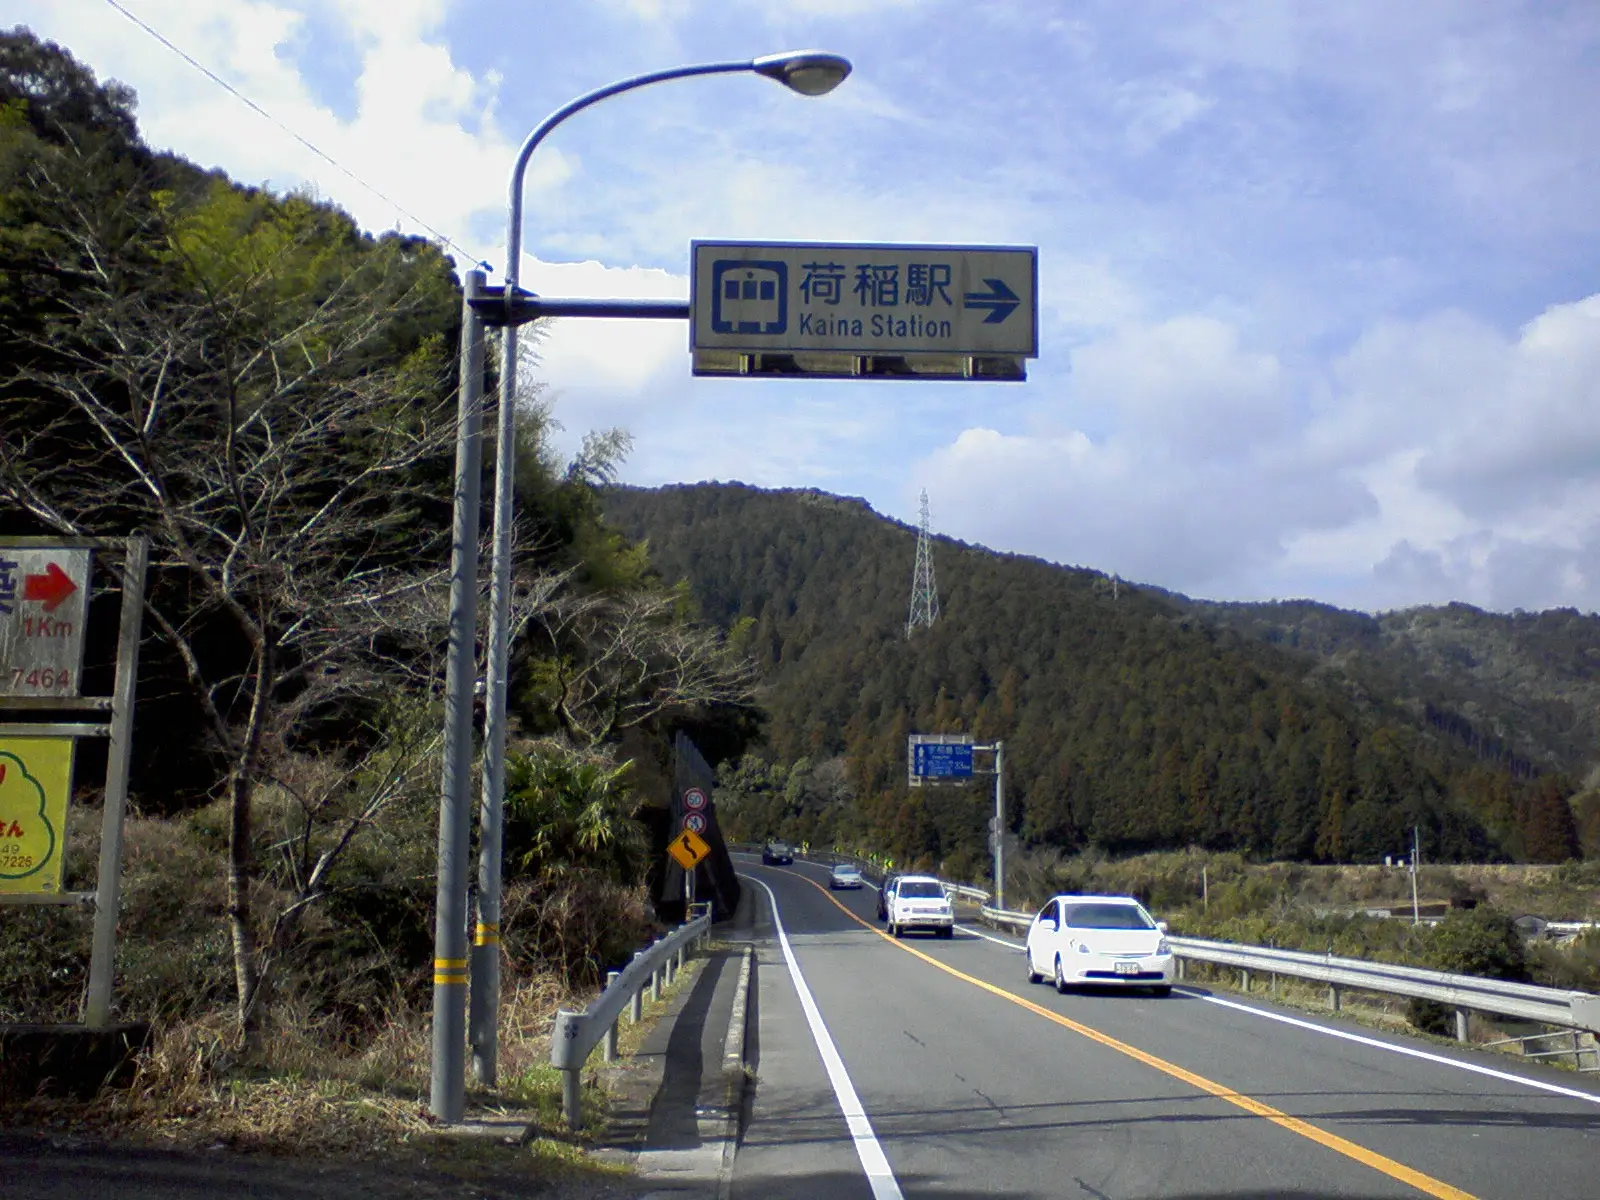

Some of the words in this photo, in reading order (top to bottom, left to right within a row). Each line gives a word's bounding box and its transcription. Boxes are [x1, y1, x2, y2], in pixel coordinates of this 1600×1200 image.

[800, 261, 953, 307] 荷稲駅
[800, 313, 863, 338] Kaina
[871, 314, 951, 338] Station
[688, 795, 702, 805] 50
